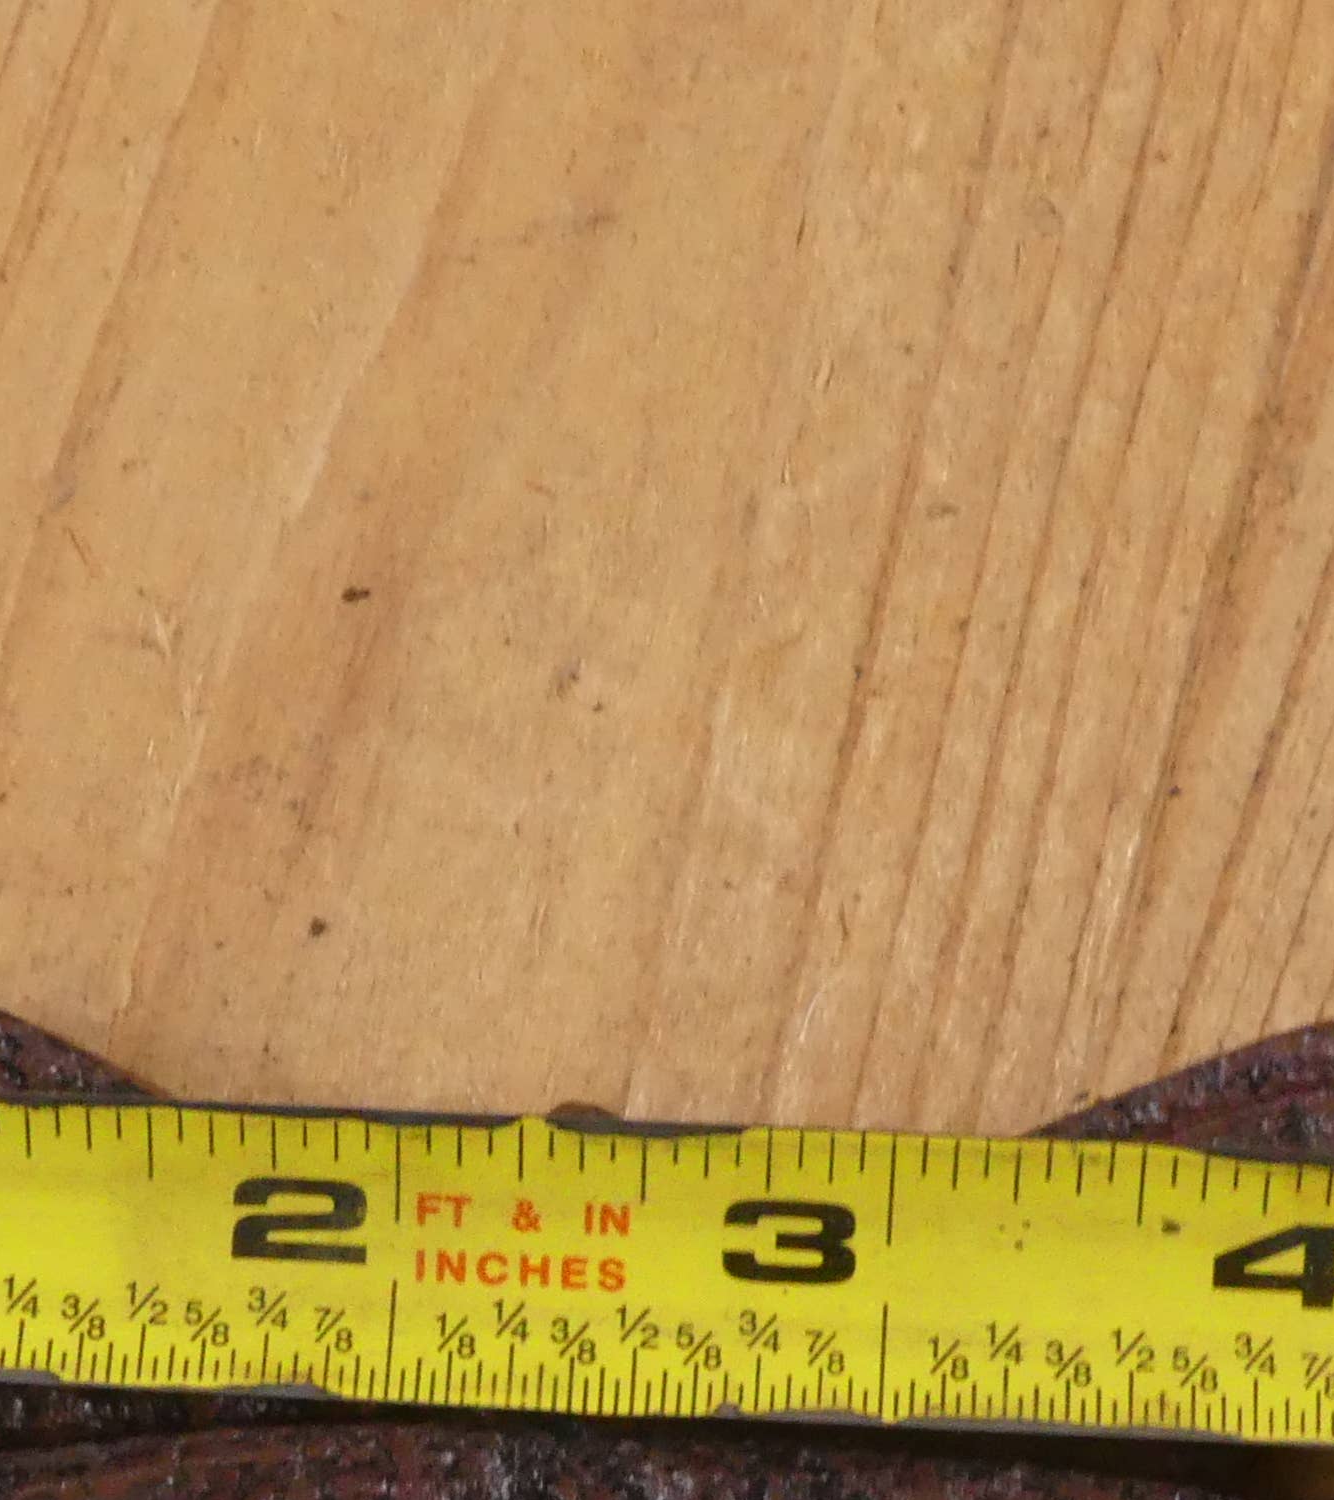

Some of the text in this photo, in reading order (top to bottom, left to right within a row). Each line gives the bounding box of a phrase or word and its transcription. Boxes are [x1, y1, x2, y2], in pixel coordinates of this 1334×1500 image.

[232, 1177, 367, 1263] 2
[416, 1192, 631, 1236] FT & IN
[722, 1200, 857, 1284] 3
[415, 1249, 627, 1293] INCHES
